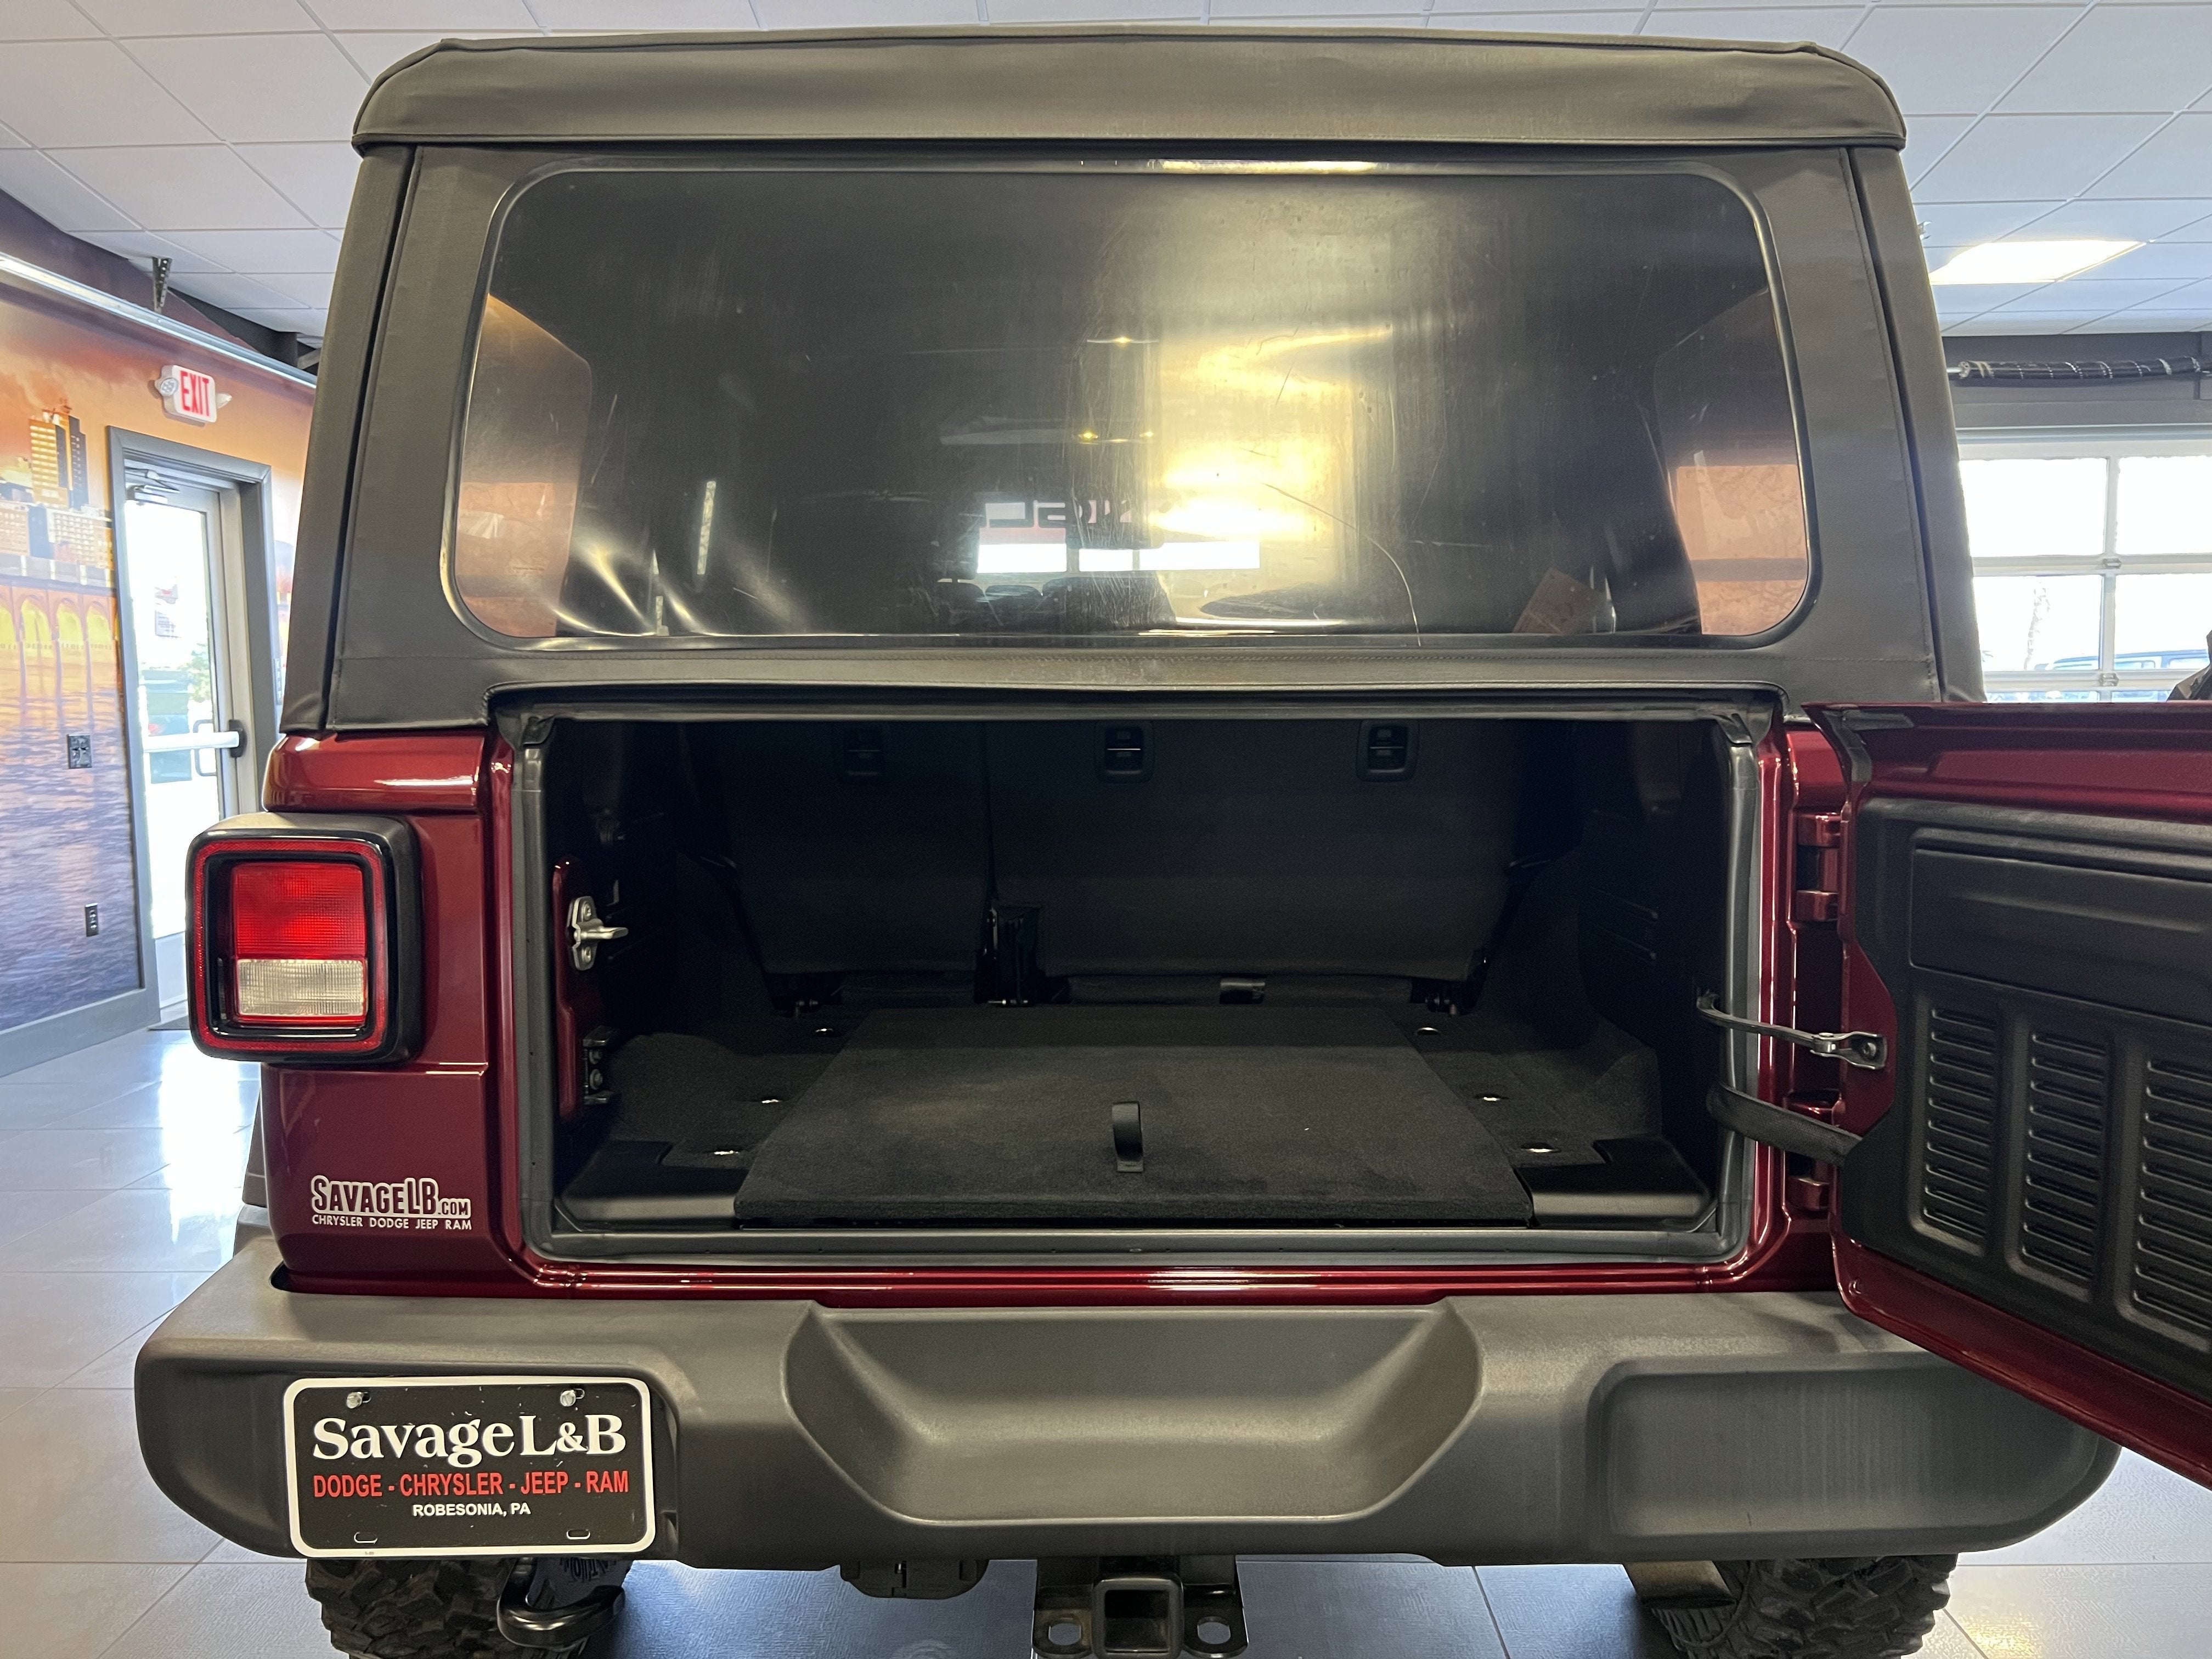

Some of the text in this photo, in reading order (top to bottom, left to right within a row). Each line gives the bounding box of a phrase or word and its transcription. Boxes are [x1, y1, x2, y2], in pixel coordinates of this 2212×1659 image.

[180, 370, 210, 417] EXIT
[312, 1214, 472, 1230] CHRYSLER DODGE JEEP RAM
[313, 1474, 382, 1498] DODGE
[399, 1472, 503, 1496] CHRYSLER
[521, 1471, 568, 1494] JEEP
[586, 1470, 629, 1493] RAM
[413, 1502, 531, 1517] ROBESONIA, PA
